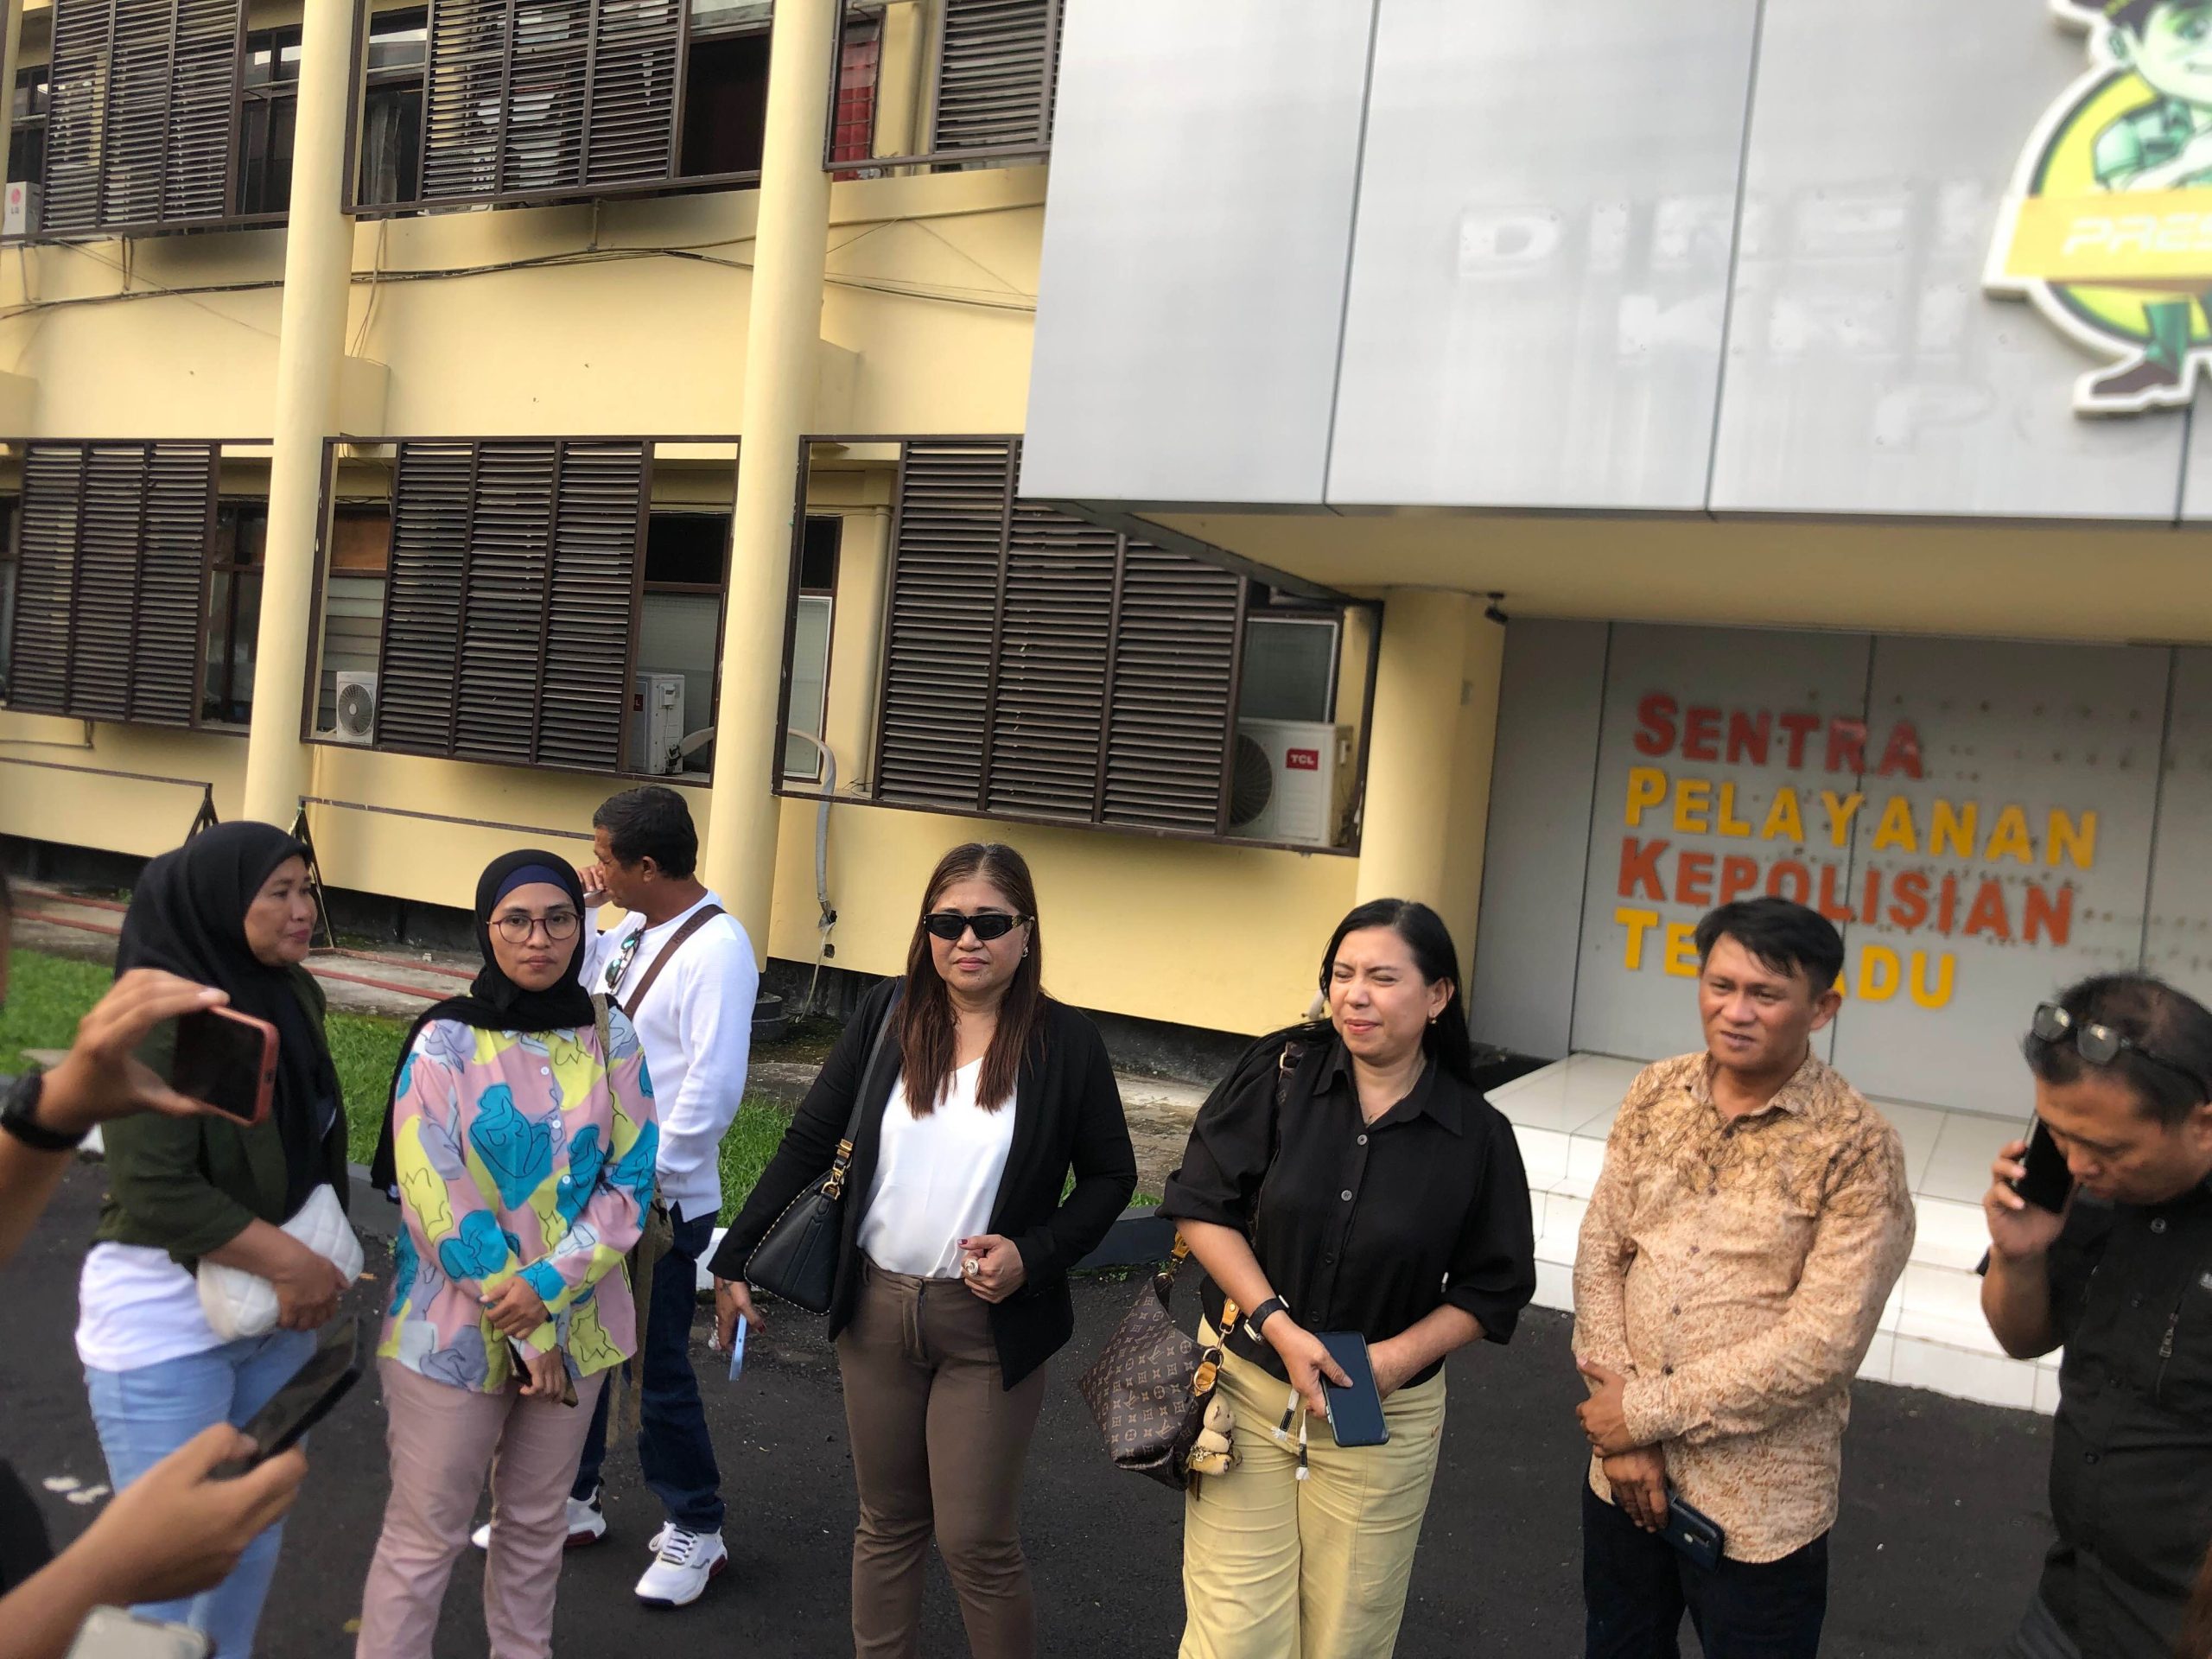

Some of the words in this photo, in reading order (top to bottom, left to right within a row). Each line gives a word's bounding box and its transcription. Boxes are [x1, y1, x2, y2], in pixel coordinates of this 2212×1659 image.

[1291, 754, 1314, 765] TCL
[1634, 691, 1924, 779] SENTRA
[1624, 766, 2099, 868] PELAYANAN
[1617, 836, 2075, 946] KEPOLISIAN
[1614, 907, 1956, 1009] TEDU
